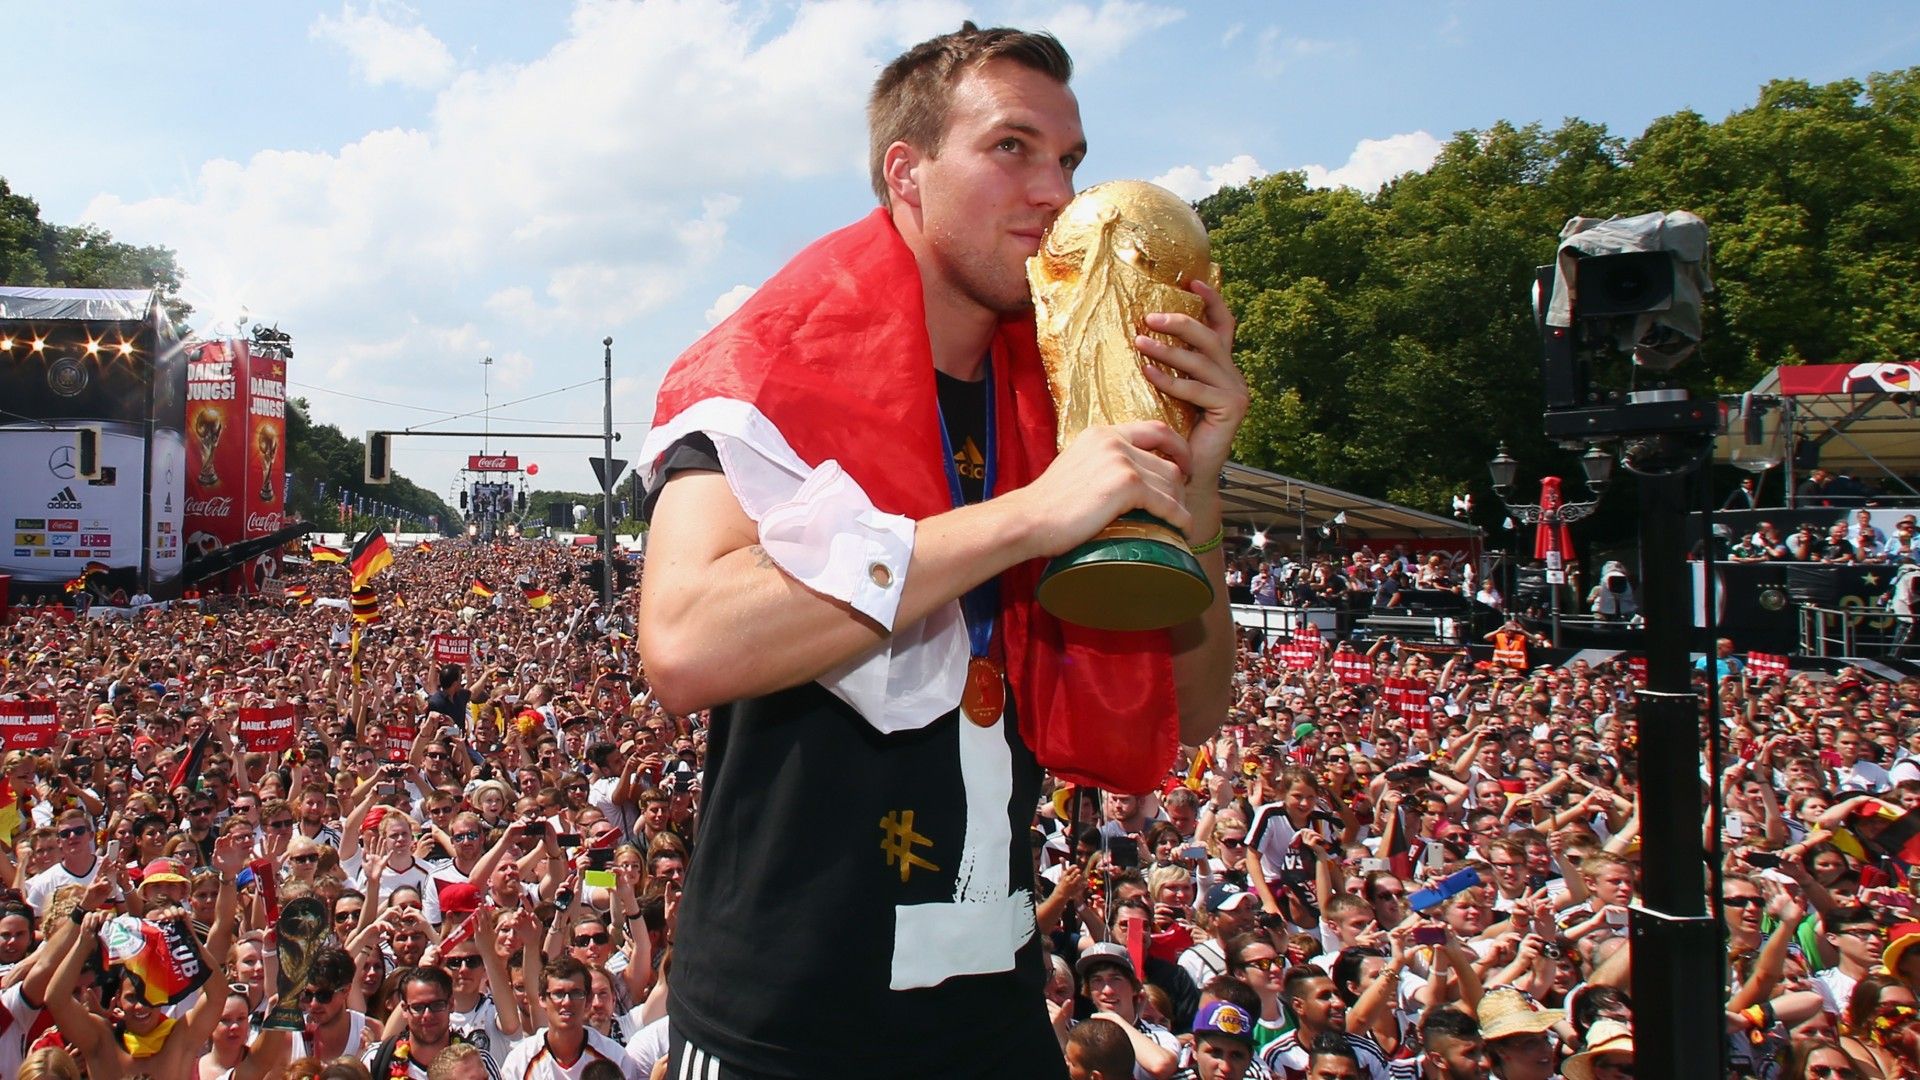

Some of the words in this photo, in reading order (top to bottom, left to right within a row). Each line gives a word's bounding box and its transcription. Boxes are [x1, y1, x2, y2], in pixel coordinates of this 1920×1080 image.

[187, 363, 236, 381] DANKE,
[187, 382, 235, 401] JUNGS!
[250, 376, 285, 401] DANKE,
[250, 397, 285, 419] JUNGS!
[478, 457, 507, 468] Coca-Cola
[47, 500, 82, 510] adidas
[26, 714, 56, 725] JUNGS!
[240, 720, 268, 731] DANKE,
[268, 716, 293, 730] JUNGS!
